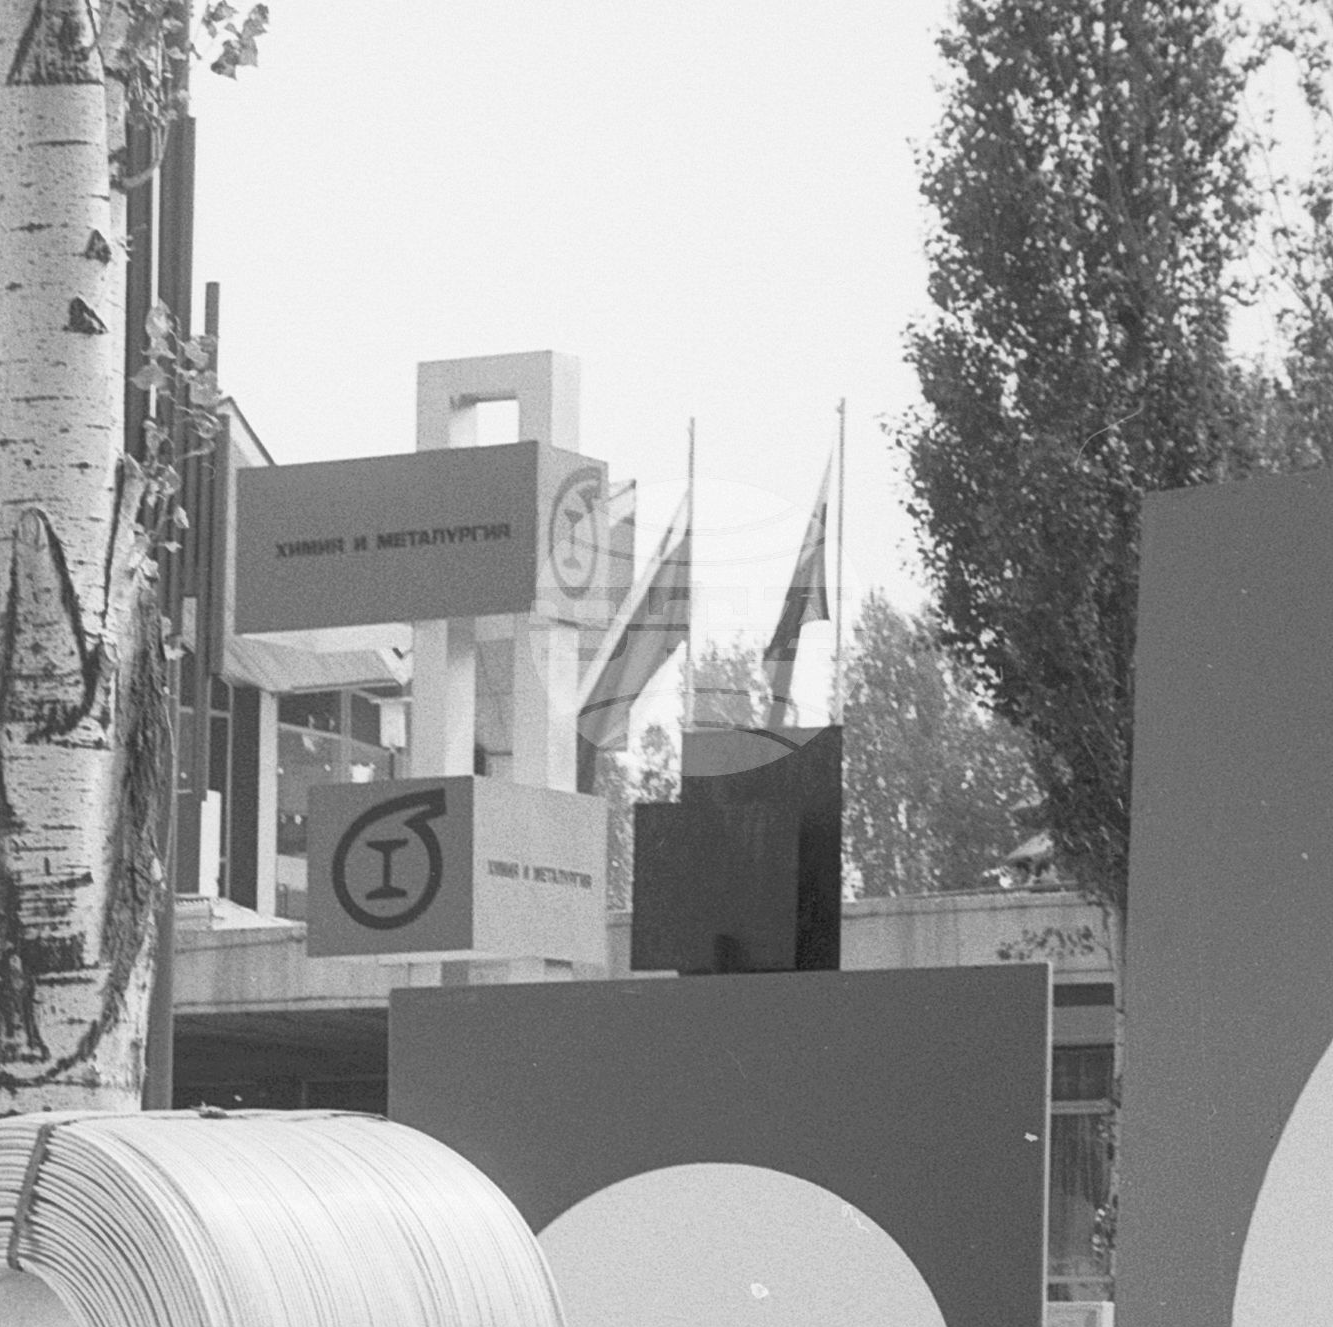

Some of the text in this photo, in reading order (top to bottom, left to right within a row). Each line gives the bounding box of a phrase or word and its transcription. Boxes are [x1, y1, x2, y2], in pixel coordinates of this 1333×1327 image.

[275, 522, 511, 559] ХИМИЯ И МЕТАЛУРГИЯ
